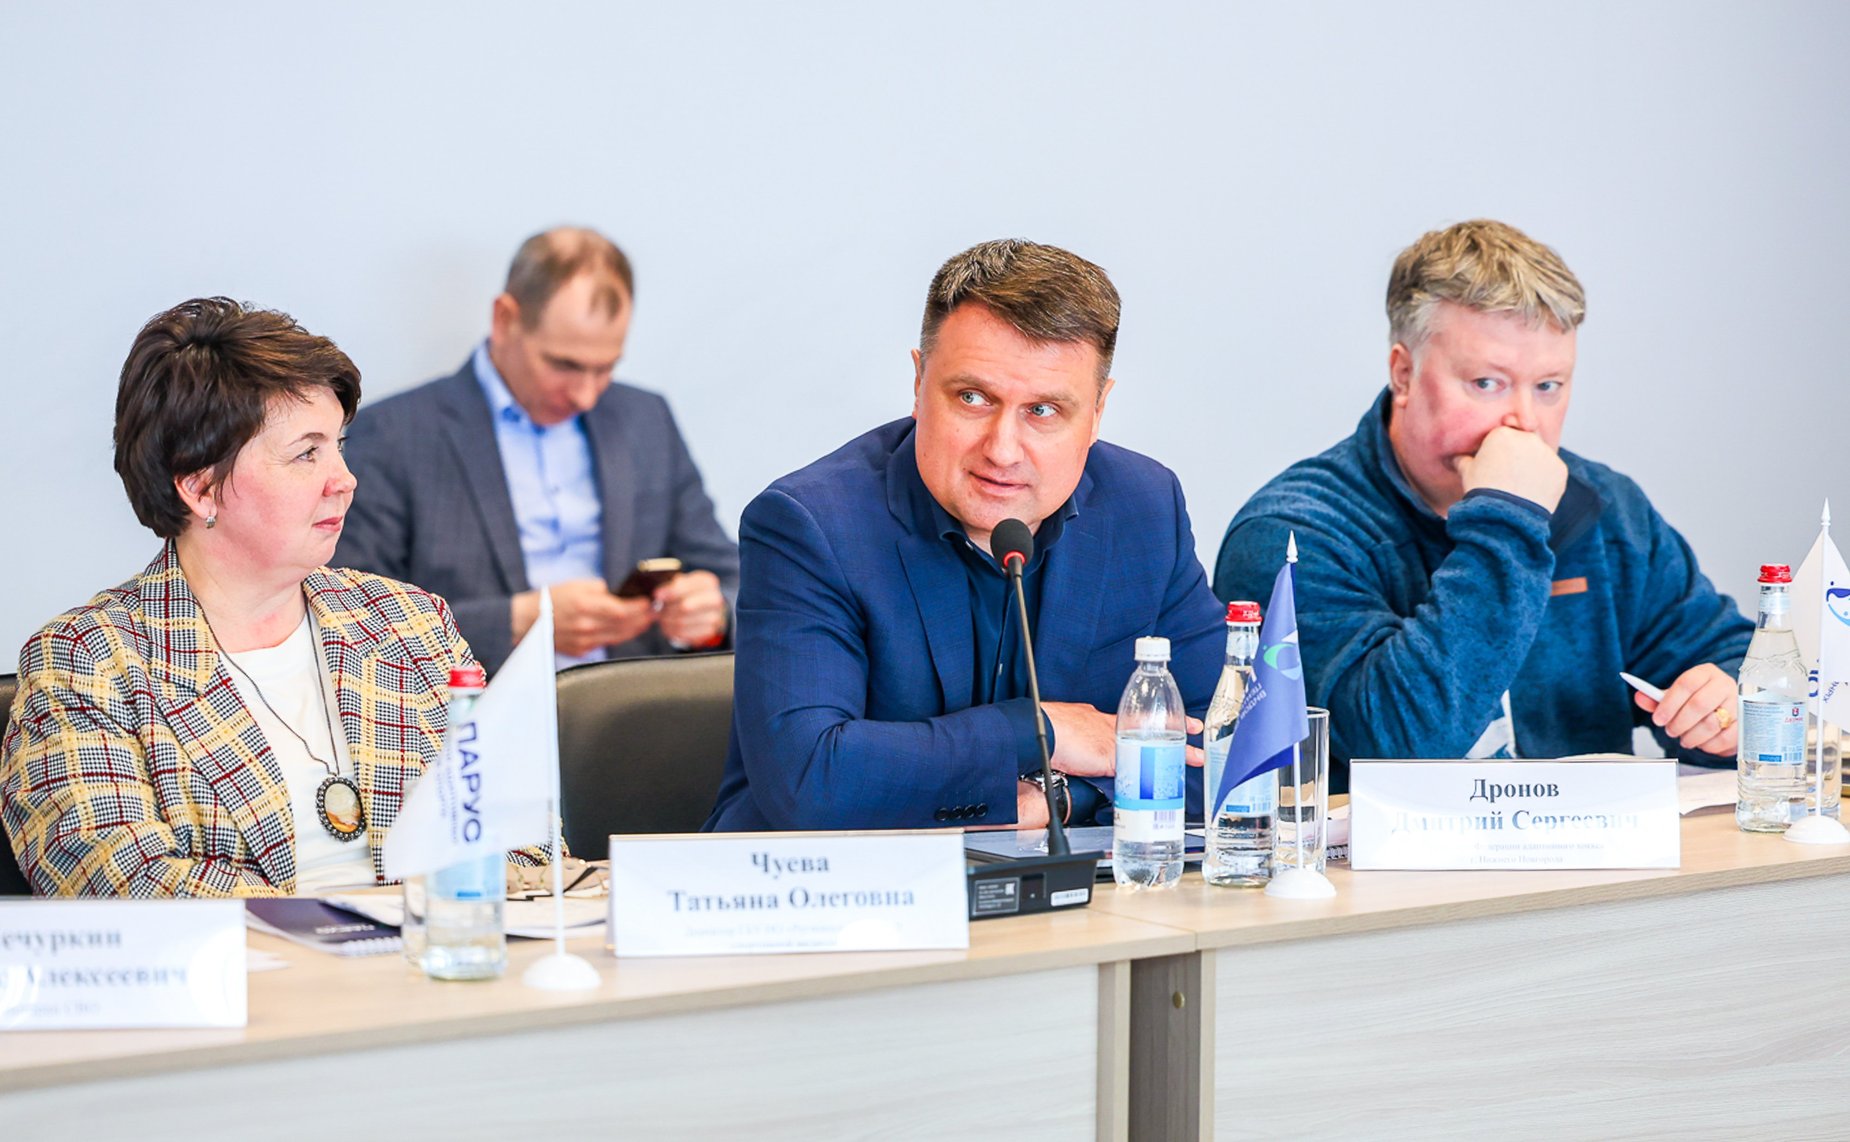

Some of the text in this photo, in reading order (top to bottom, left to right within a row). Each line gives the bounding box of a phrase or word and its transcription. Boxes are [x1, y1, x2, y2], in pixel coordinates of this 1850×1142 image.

[458, 721, 482, 843] ПАРУС
[1469, 778, 1560, 803] Дронов
[750, 851, 831, 880] Чуева
[666, 886, 916, 913] Татьяна Олеговна
